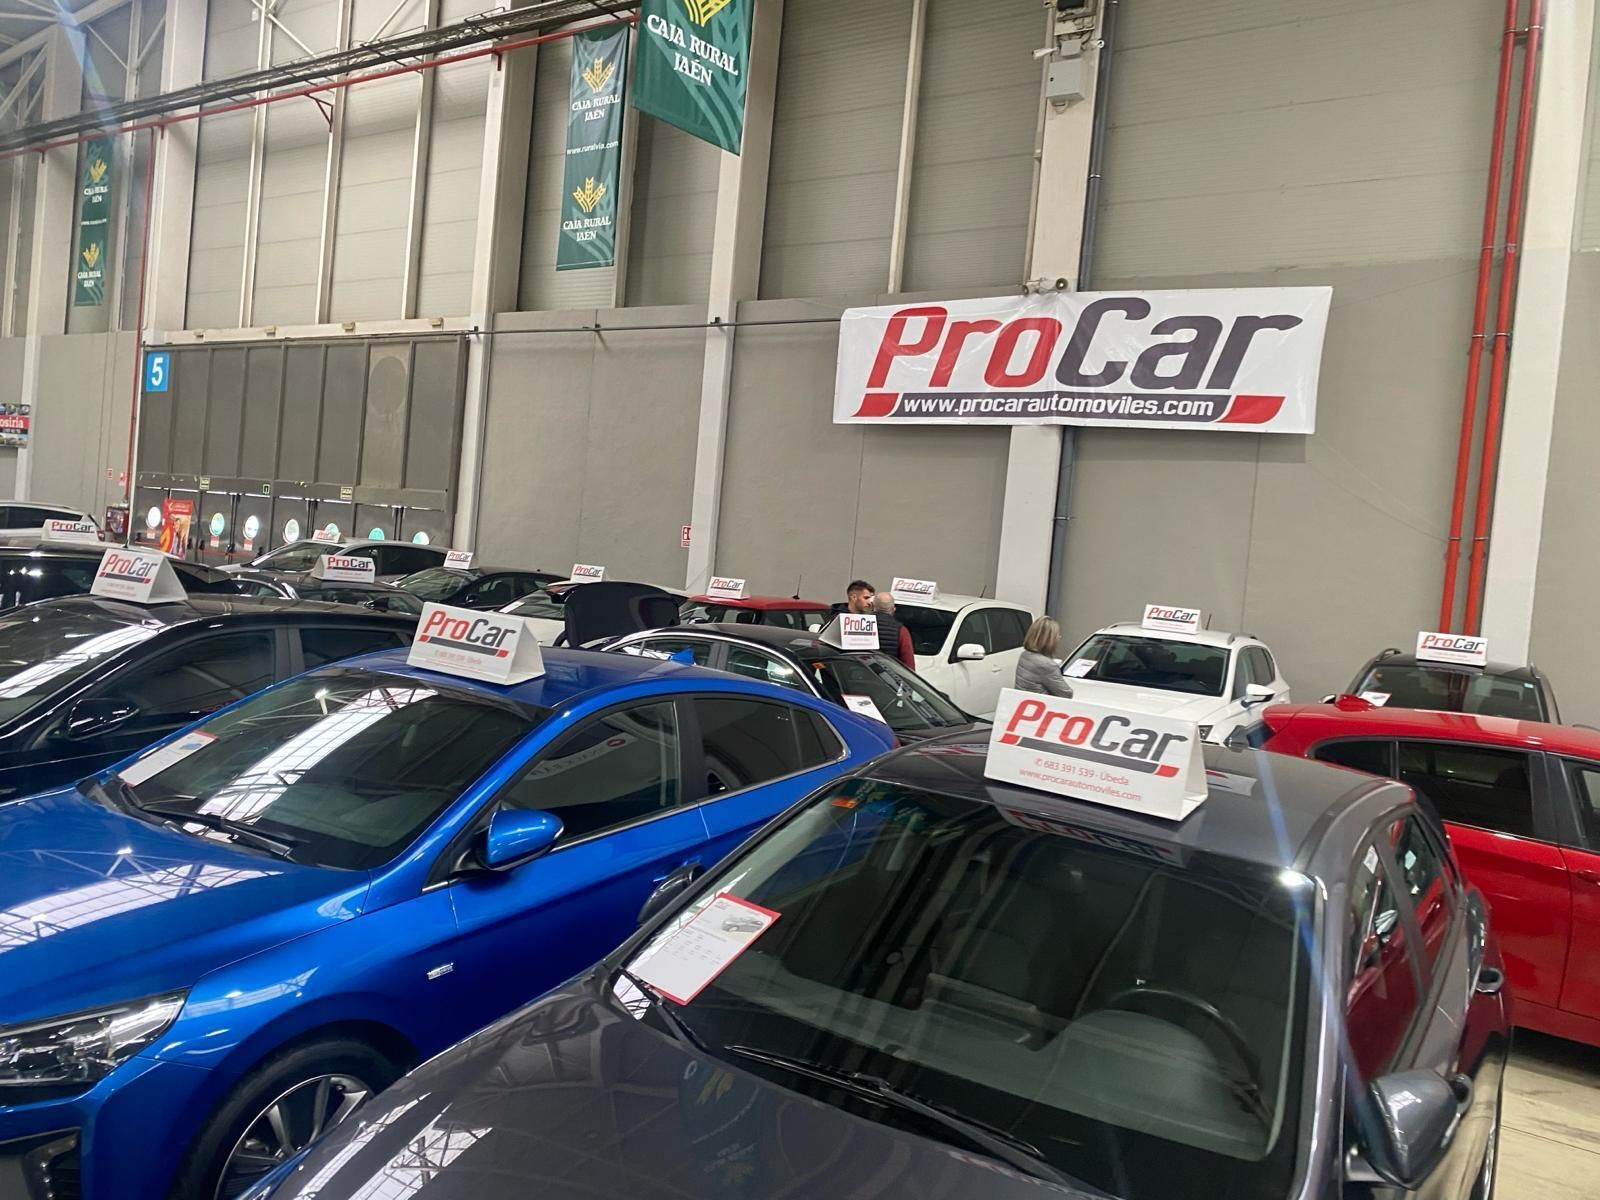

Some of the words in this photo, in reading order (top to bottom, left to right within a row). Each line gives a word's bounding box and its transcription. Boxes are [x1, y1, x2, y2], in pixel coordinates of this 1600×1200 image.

[647, 14, 687, 48] CAJA
[689, 34, 739, 76] RURAL
[673, 52, 713, 86] JAÉN
[572, 99, 592, 111] CAJA
[593, 94, 621, 108] RURAL
[566, 140, 619, 155] www.ruralvia.com
[563, 219, 583, 230] CAJA
[583, 215, 612, 228] RURAL
[866, 296, 1303, 391] ProCar
[151, 357, 164, 386] 5
[903, 393, 1214, 418] www.procarautomoviles.com
[51, 521, 94, 531] ProCar
[103, 553, 158, 577] ProCar
[327, 556, 372, 569] ProCar
[895, 579, 934, 593] ProCar
[1148, 607, 1198, 621] ProCar
[422, 610, 517, 648] ProCar
[844, 616, 876, 632] ProCar
[1422, 634, 1485, 650] ProCar
[1006, 699, 1189, 763] ProCar
[1043, 760, 1060, 771] 683
[1061, 763, 1076, 774] 391
[1078, 767, 1095, 778] 539
[1019, 768, 1142, 802] www.procarautomoviles.com
